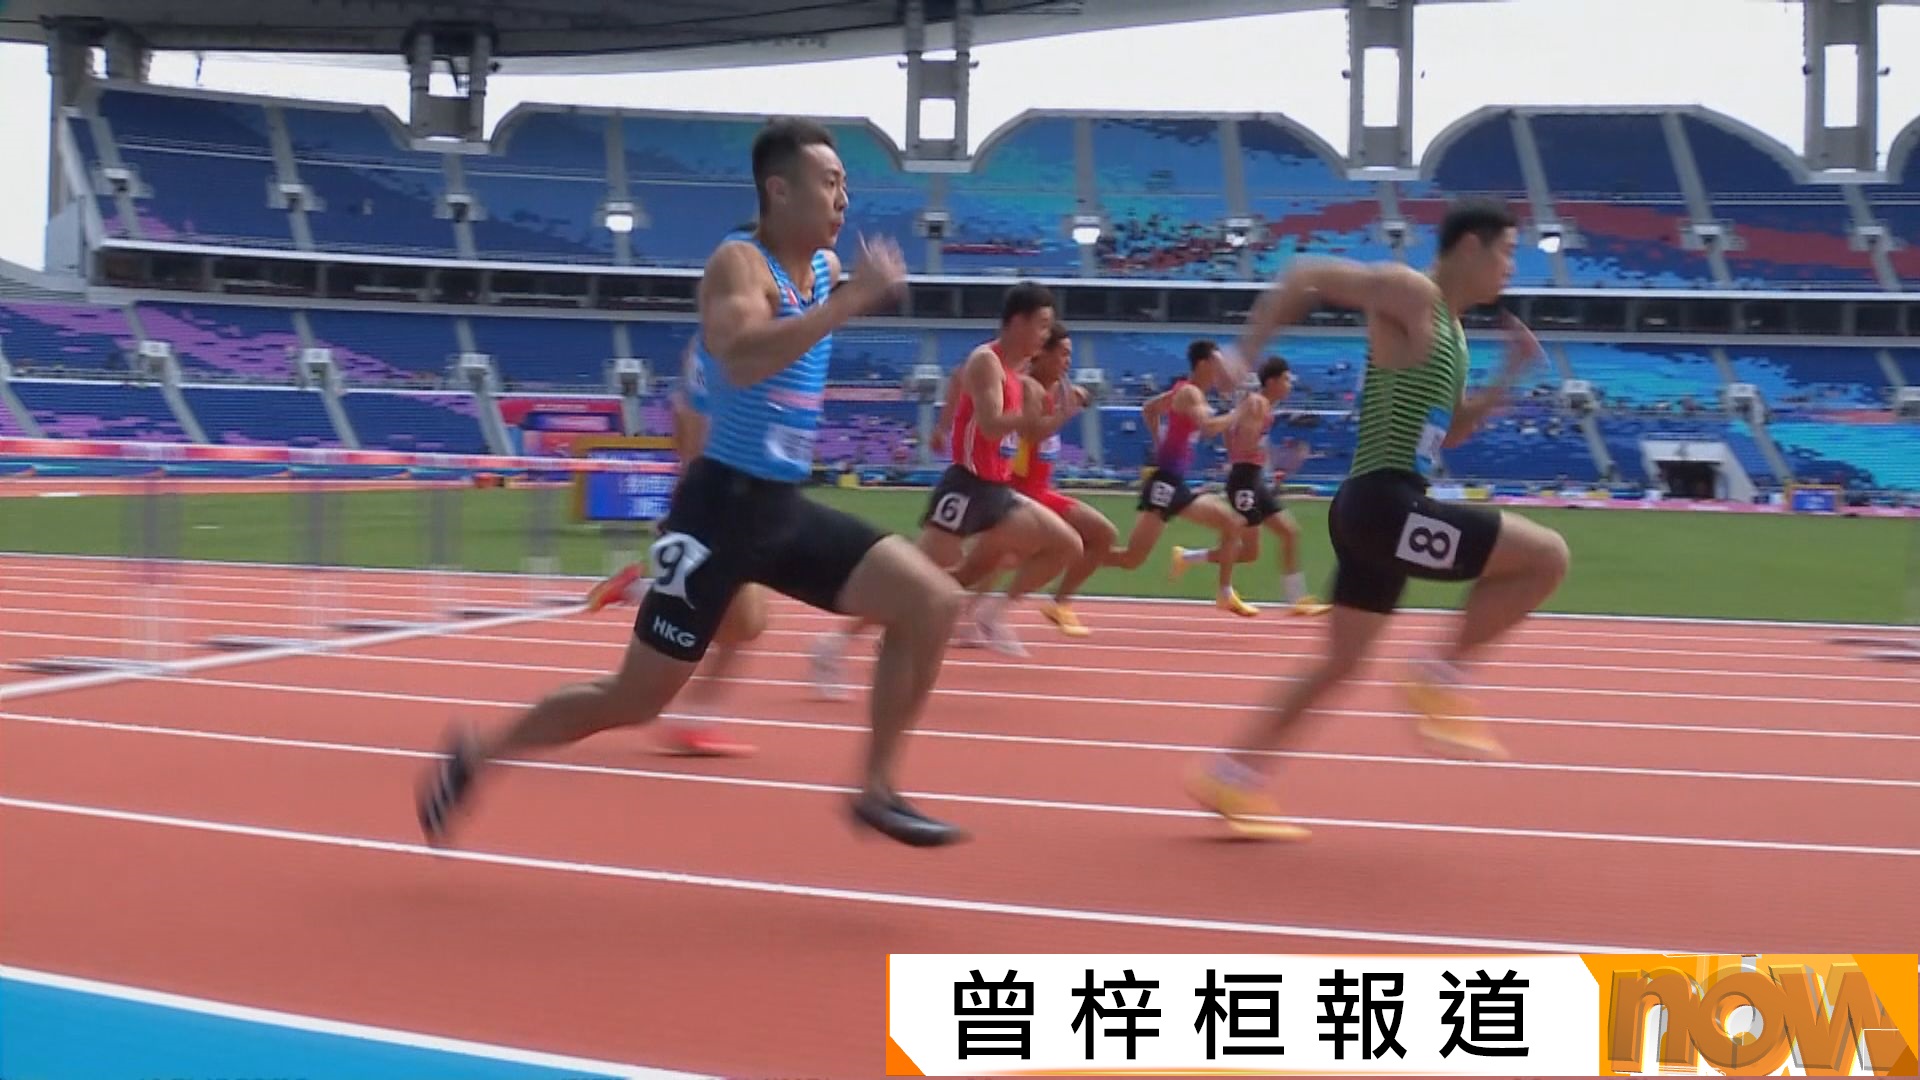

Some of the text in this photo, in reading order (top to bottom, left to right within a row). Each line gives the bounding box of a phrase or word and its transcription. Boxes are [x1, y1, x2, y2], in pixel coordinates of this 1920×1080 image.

[941, 497, 958, 523] 6
[1409, 526, 1450, 560] 8
[656, 541, 685, 586] 9
[653, 615, 697, 648] HKG
